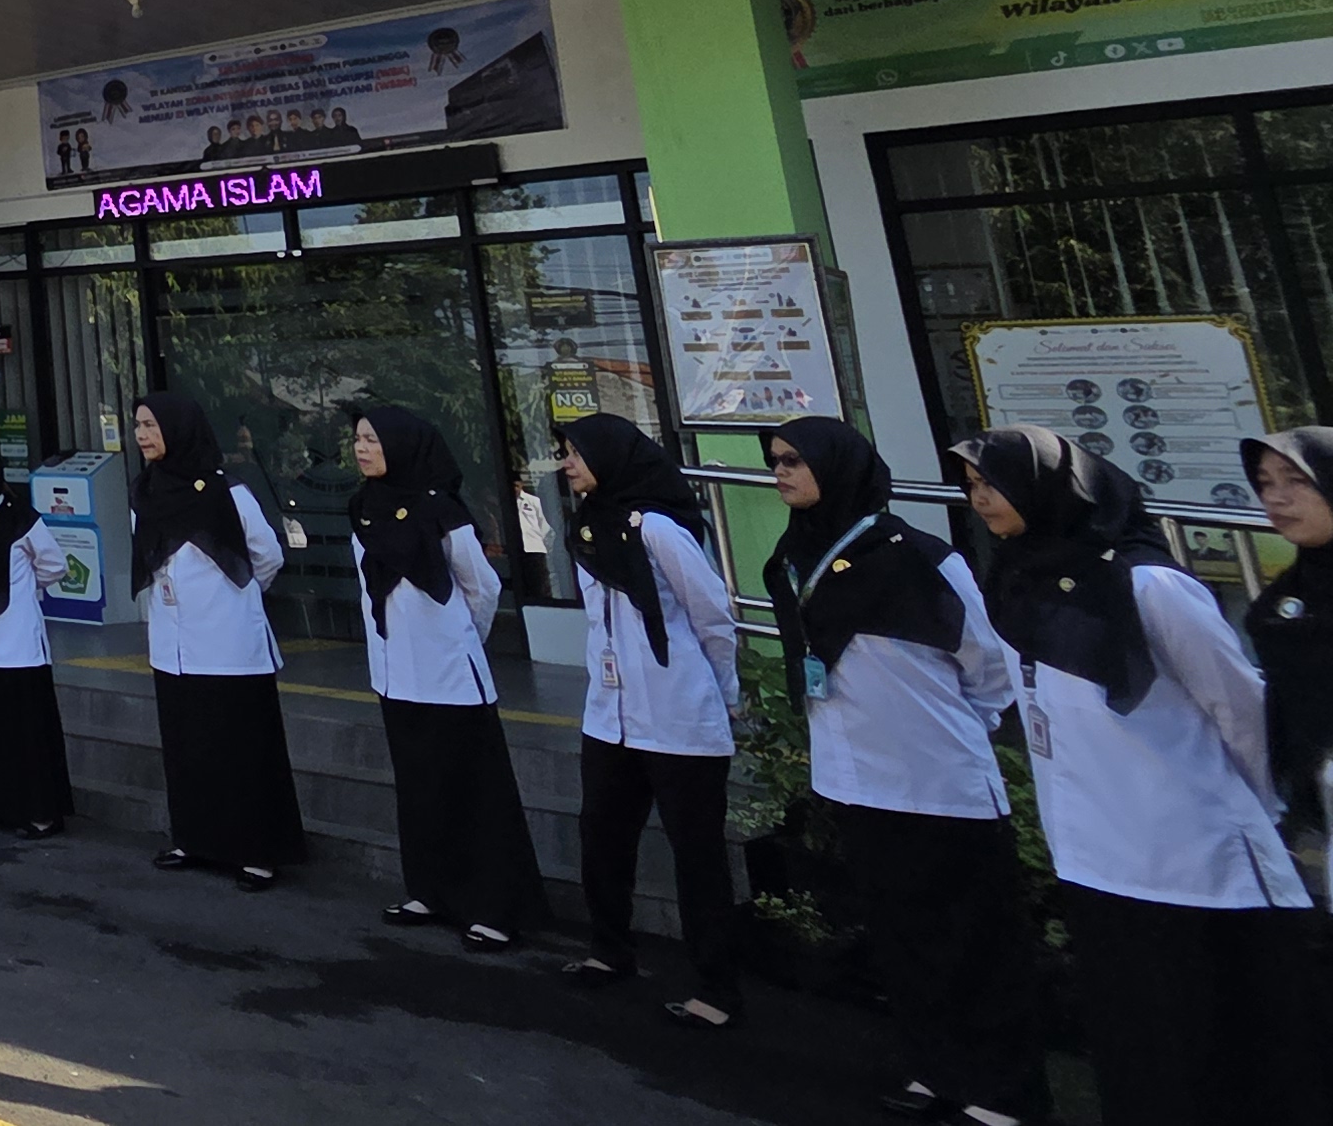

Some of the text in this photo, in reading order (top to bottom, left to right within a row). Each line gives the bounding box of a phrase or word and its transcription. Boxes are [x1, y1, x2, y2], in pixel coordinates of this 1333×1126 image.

[160, 84, 192, 96] KANTOR
[142, 99, 183, 112] WILAYAH
[186, 104, 230, 118] WILAYAH
[98, 169, 323, 220] AGAMA ISLAM
[556, 393, 598, 407] NOL
[4, 414, 27, 423] JAM
